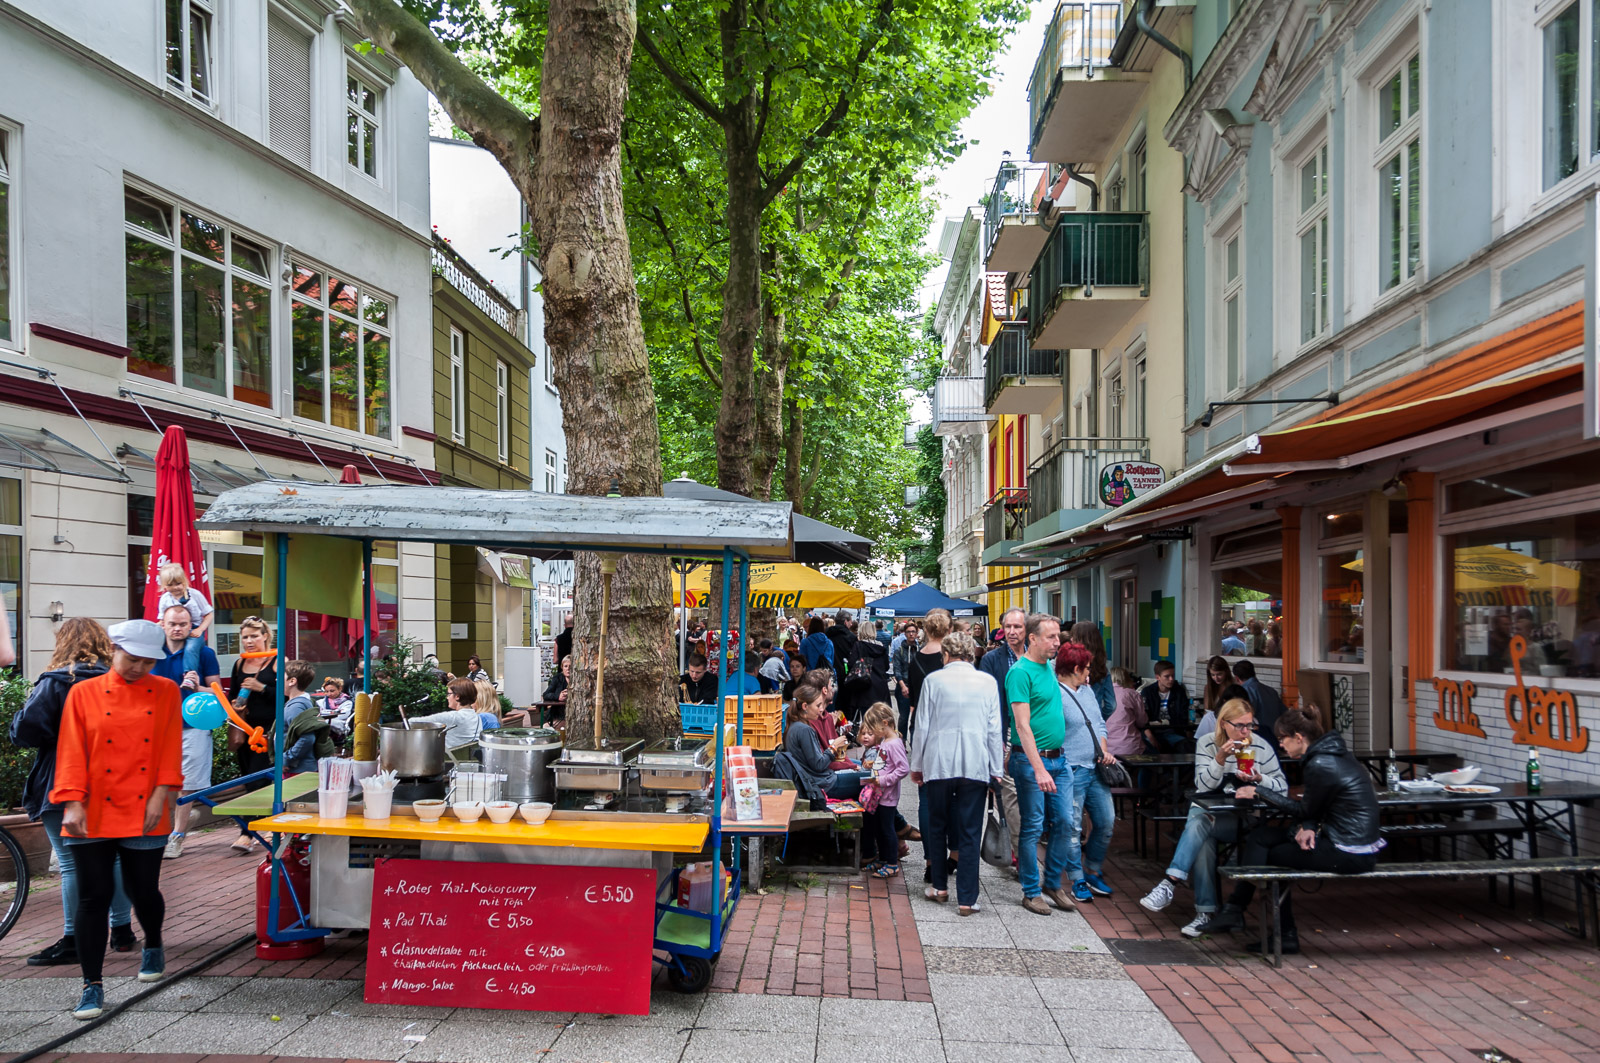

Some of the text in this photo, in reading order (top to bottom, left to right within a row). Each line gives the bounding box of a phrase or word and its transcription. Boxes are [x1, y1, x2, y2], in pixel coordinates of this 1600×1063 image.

[1125, 463, 1160, 476] Rothaus
[749, 589, 803, 608] iguel
[396, 879, 432, 894] Rotes
[478, 896, 500, 906] mit
[395, 912, 415, 927] Pad
[420, 912, 448, 927] Thai
[468, 947, 488, 957] mit
[528, 963, 549, 972] oder
[391, 978, 455, 993] Mango-Salat
